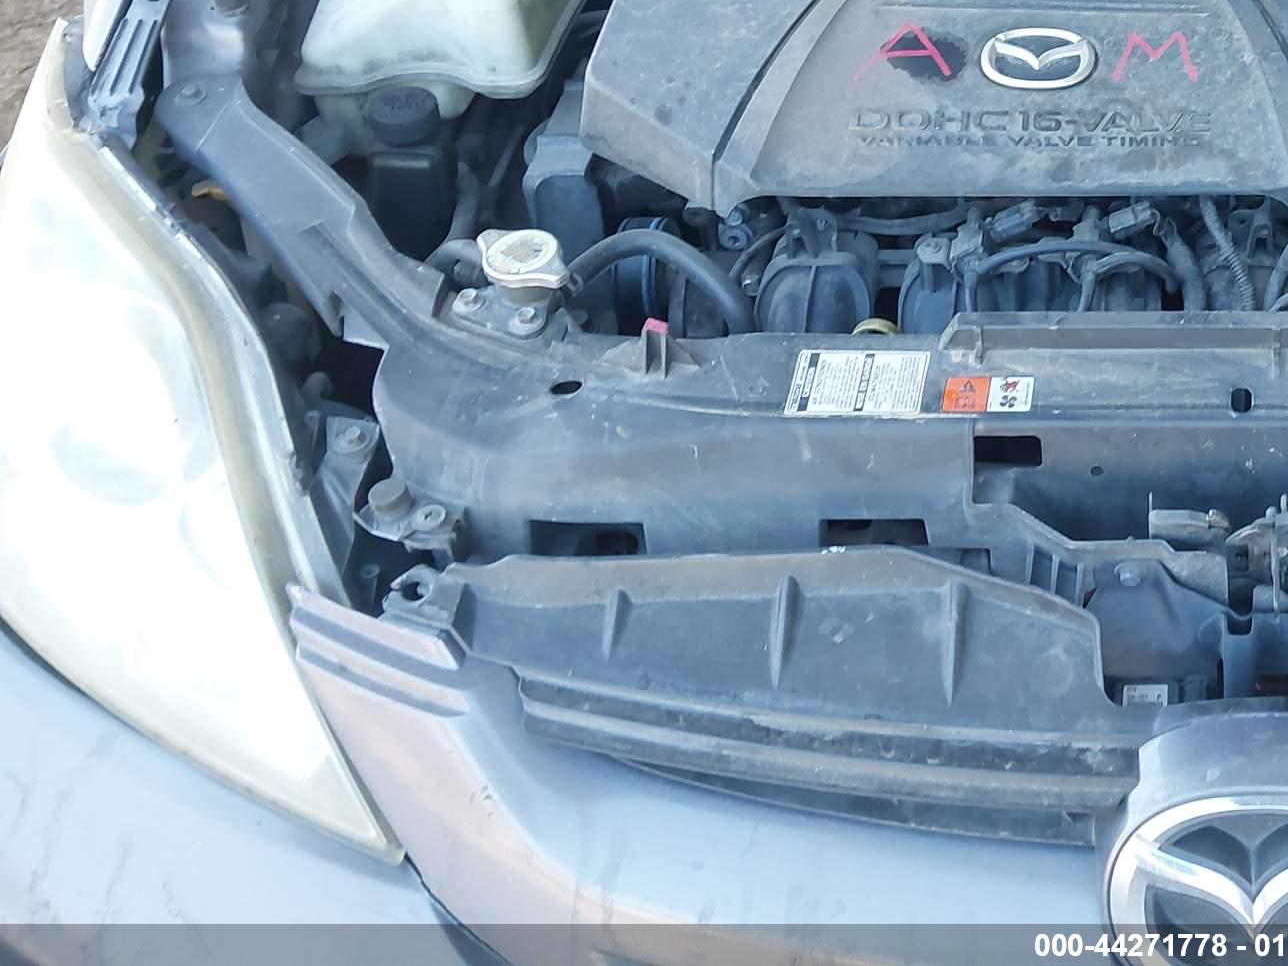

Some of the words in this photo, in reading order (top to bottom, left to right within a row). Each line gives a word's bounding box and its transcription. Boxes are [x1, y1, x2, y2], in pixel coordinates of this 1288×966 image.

[848, 109, 1009, 133] DOHC
[1018, 109, 1213, 133] 16-VALVE
[857, 135, 999, 148] VARIABLE
[1010, 135, 1095, 148] VALVE
[1101, 135, 1203, 148] TIMING
